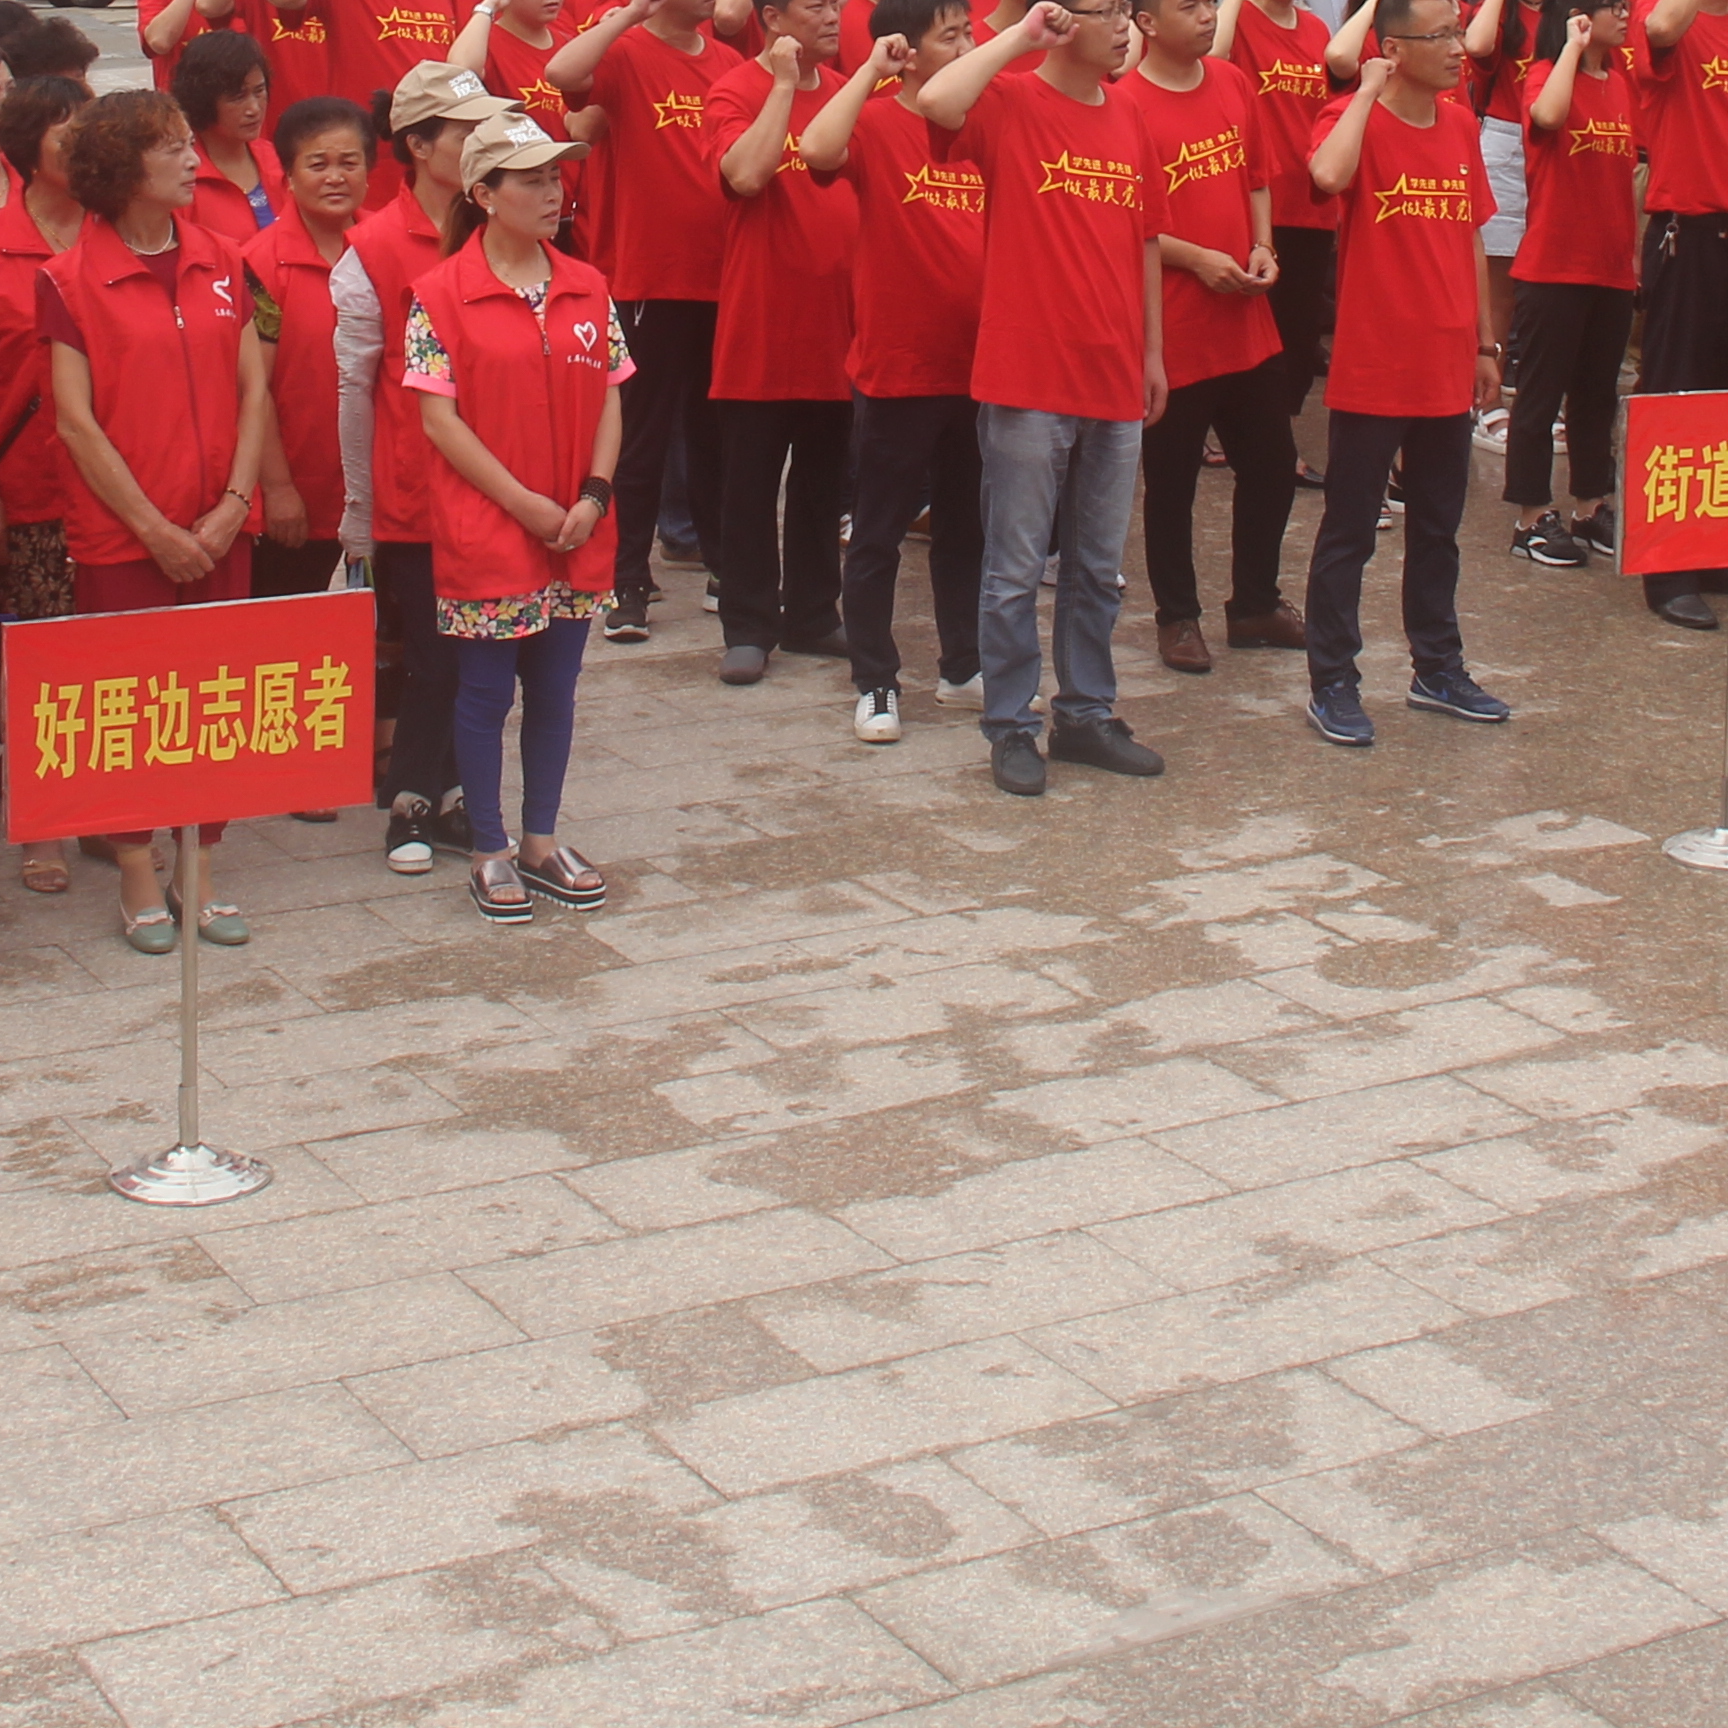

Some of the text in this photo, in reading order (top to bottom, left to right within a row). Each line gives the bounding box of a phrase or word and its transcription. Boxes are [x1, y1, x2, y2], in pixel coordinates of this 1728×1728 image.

[33, 654, 353, 780] 好厝边志愿者
